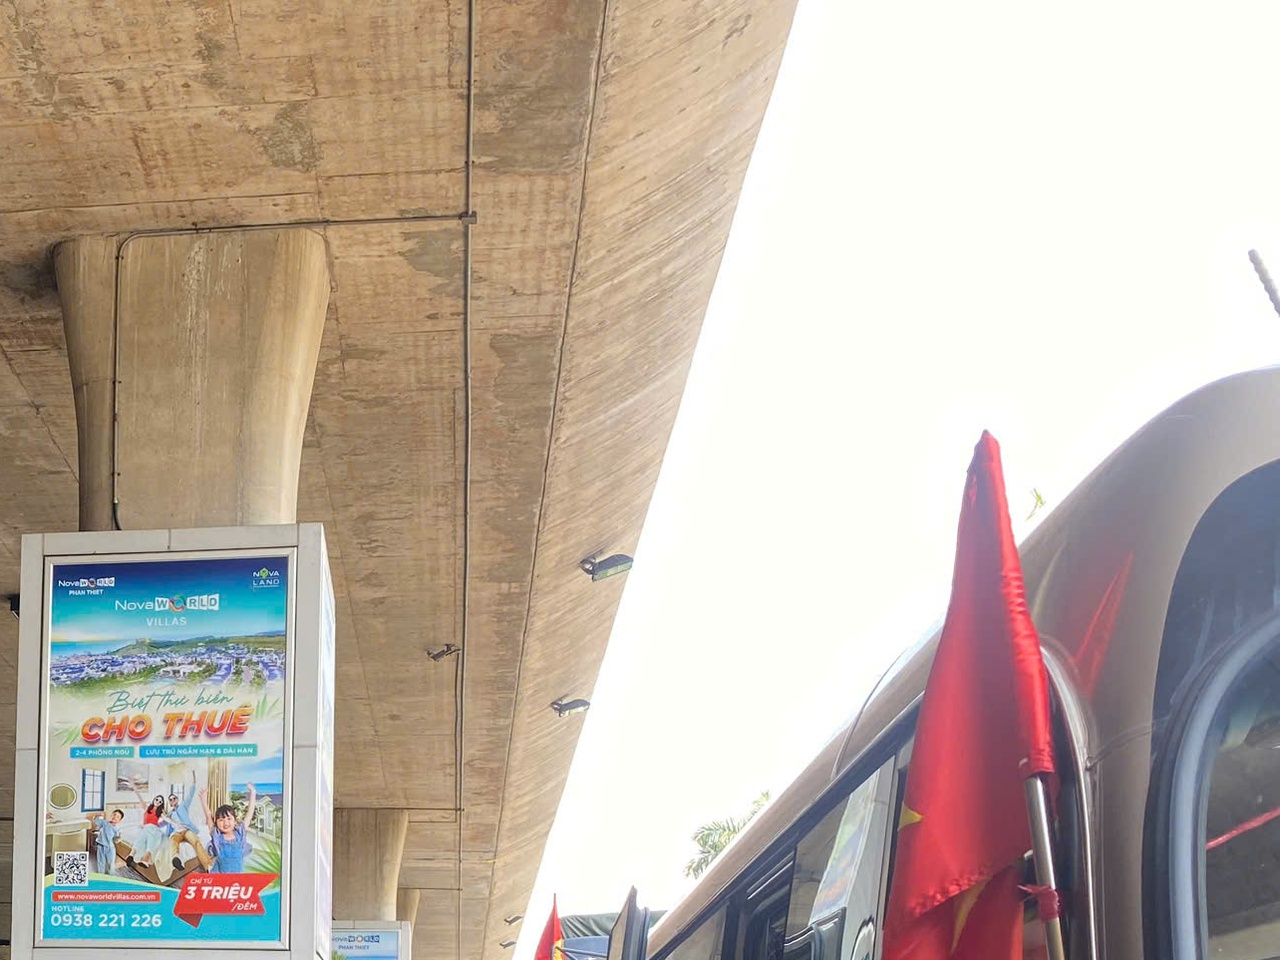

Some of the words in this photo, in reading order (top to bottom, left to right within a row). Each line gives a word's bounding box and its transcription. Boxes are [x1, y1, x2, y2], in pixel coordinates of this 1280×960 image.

[115, 594, 220, 612] NovaWORLD
[146, 616, 188, 627] VILLAS
[81, 713, 154, 744] CHO
[163, 701, 255, 740] THUÊ
[75, 749, 87, 757] 2-4
[57, 893, 156, 901] www.novaworldvillas.com.vn
[185, 886, 197, 899] 3
[201, 882, 254, 903] TRIỆU
[231, 901, 258, 912] /ĐÊM
[50, 913, 93, 927] 0938
[98, 913, 125, 927] 221
[131, 913, 162, 927] 226
